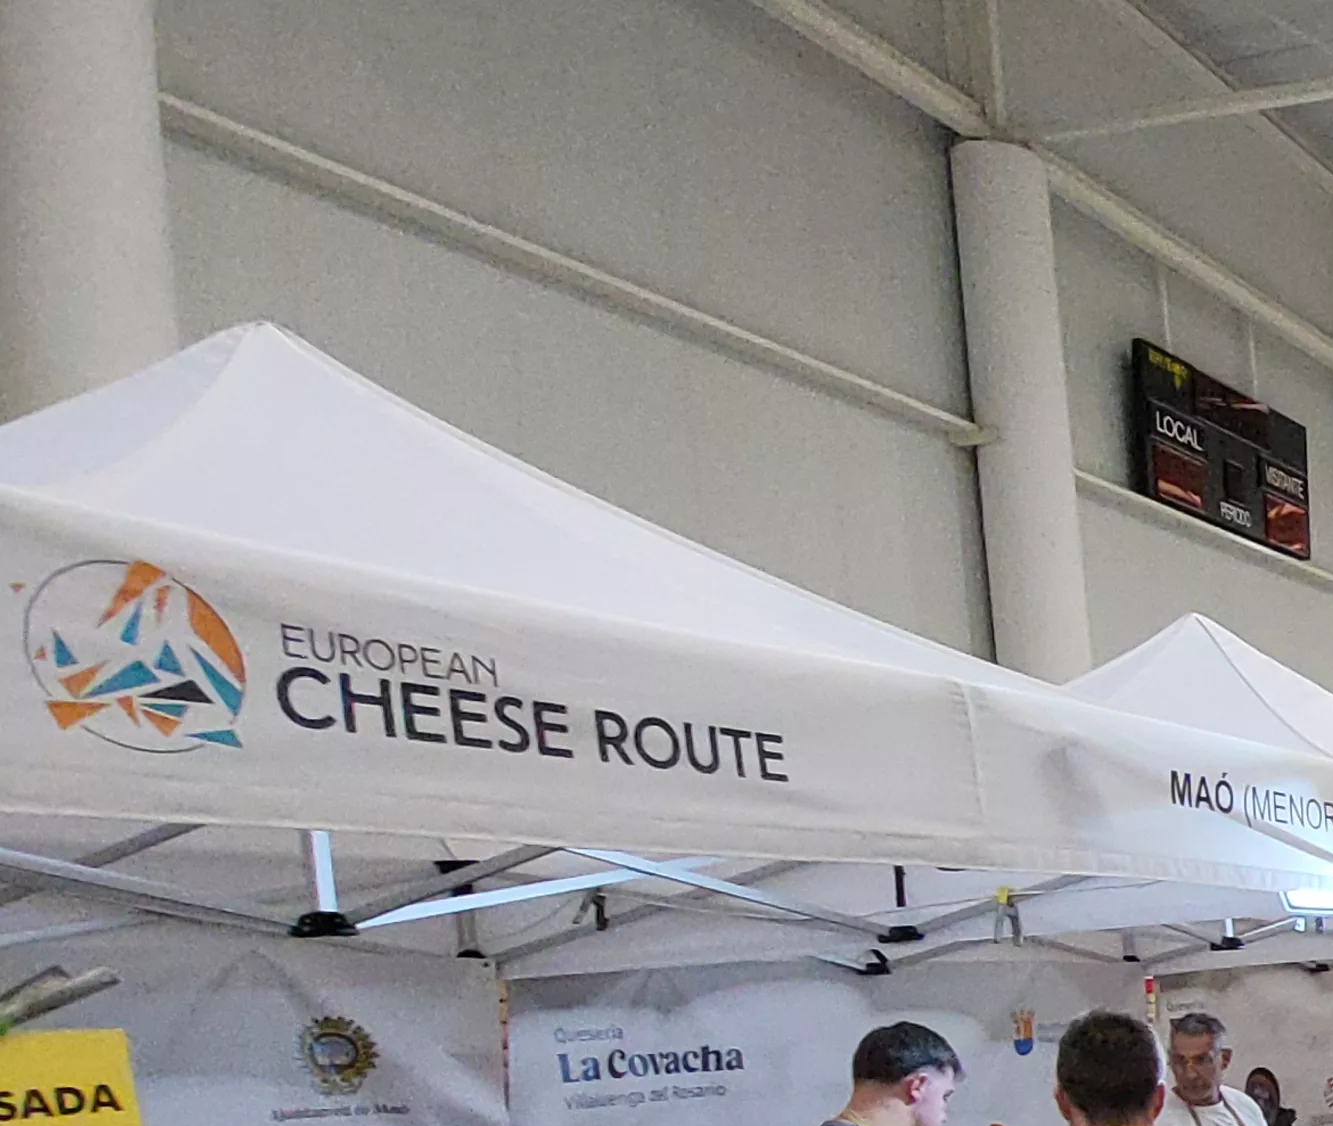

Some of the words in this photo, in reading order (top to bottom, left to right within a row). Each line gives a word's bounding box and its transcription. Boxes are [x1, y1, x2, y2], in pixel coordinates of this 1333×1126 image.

[1155, 411, 1204, 452] LOCAL
[280, 624, 498, 687] EUROPEAN
[276, 667, 573, 758] CHEESE
[598, 710, 789, 783] ROUTE
[1170, 770, 1235, 815] MAÓ
[556, 1052, 602, 1084] La
[606, 1044, 746, 1079] Covacha
[0, 1084, 125, 1122] SADA
